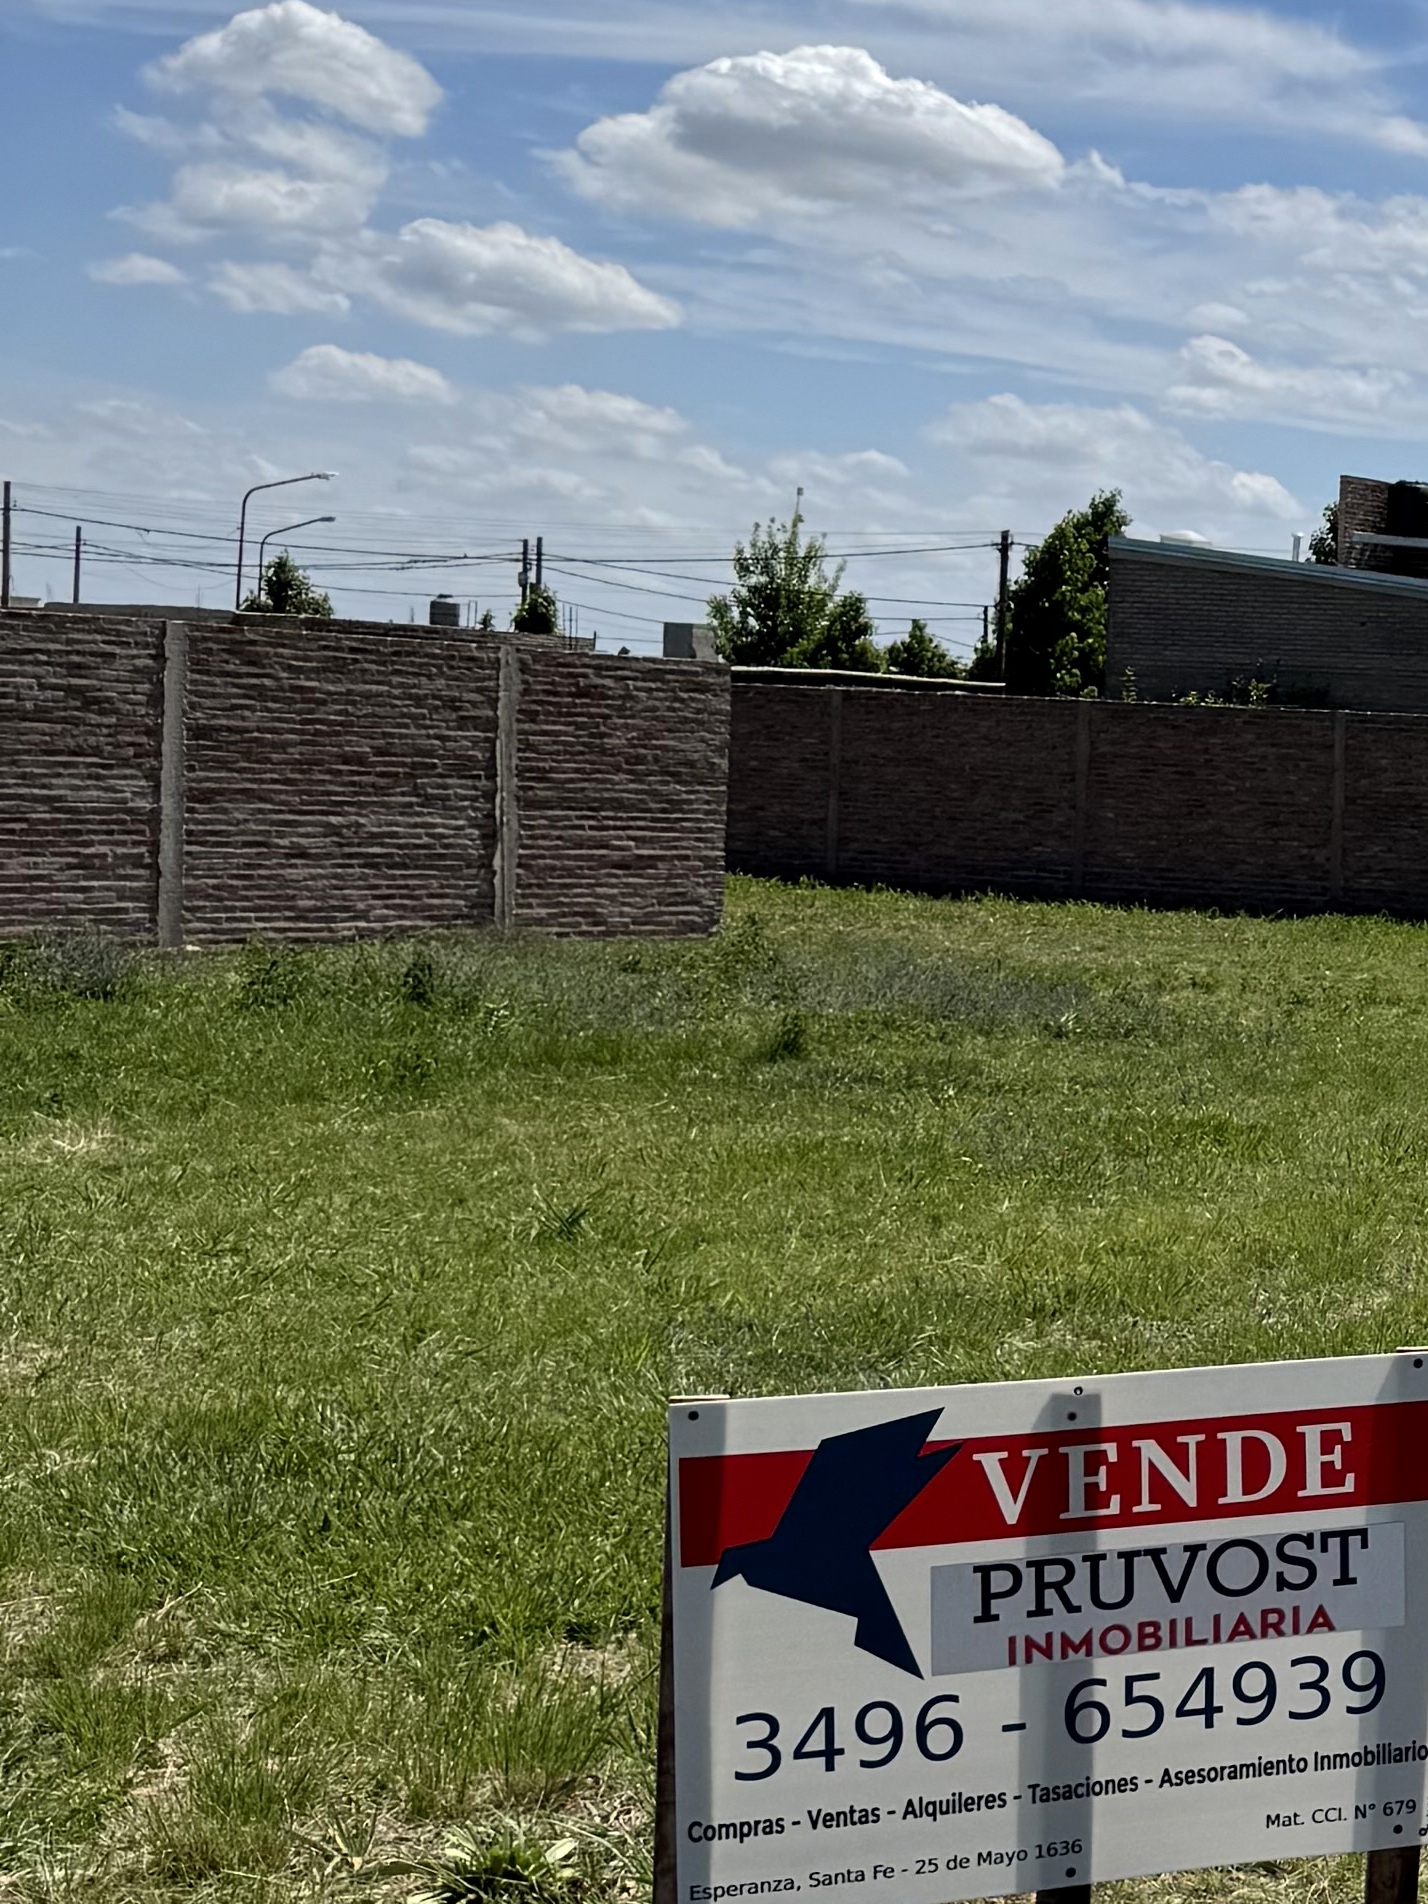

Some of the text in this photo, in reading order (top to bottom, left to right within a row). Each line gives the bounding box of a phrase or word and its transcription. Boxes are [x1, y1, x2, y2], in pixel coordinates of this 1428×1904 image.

[972, 1422, 1355, 1525] VENDE
[973, 1527, 1369, 1624] PRUVOST
[1008, 1604, 1336, 1666] INMOBILIARIA
[734, 1649, 1387, 1782] 3496 - 654939
[687, 1815, 786, 1844] Compras
[807, 1805, 881, 1831] Ventas
[902, 1790, 1007, 1822] Alquileres
[1027, 1775, 1139, 1805] Tasaciones
[1159, 1752, 1308, 1789] Asesoramiento
[1265, 1812, 1304, 1829] Mat.
[1382, 1799, 1417, 1817] 679
[689, 1876, 802, 1902] Esperanza,
[808, 1868, 866, 1889] Santa
[872, 1863, 895, 1881] Fe
[914, 1857, 940, 1876] 25
[946, 1853, 971, 1871] de
[976, 1846, 1029, 1866] Mayo
[1034, 1839, 1083, 1859] 1636
